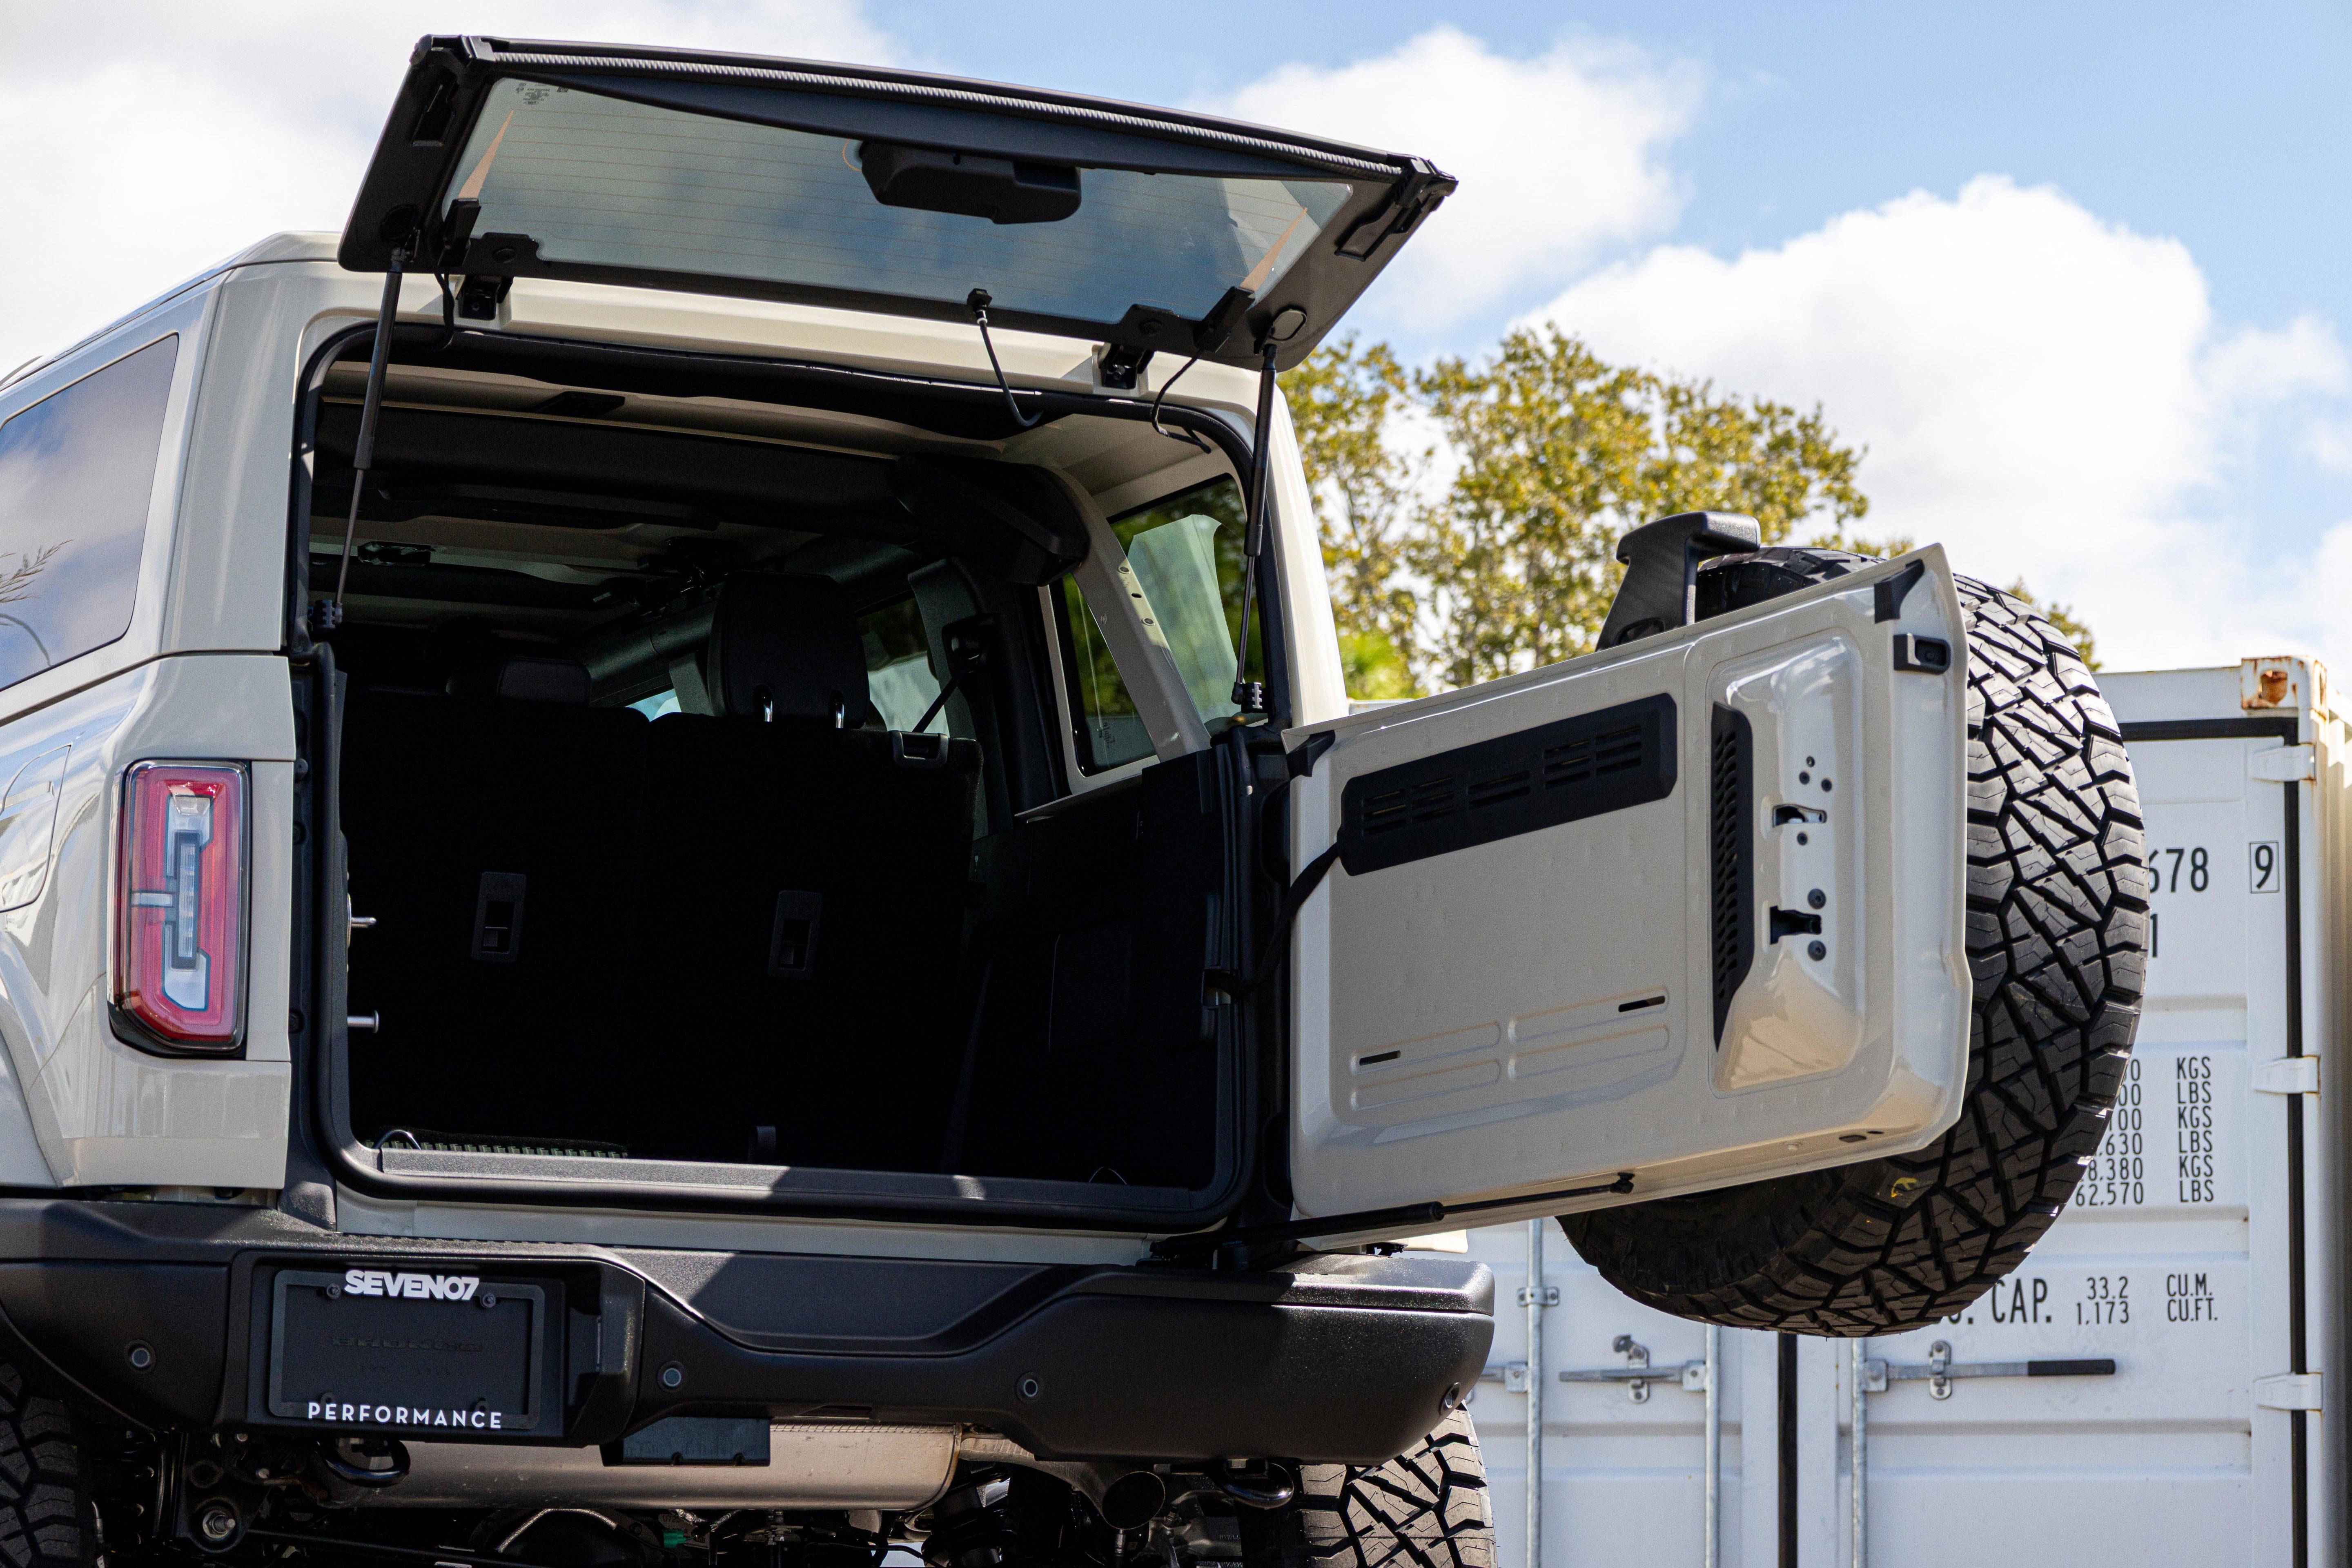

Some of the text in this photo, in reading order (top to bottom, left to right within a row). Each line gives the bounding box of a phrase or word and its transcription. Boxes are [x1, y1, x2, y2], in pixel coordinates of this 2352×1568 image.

[2256, 845, 2274, 889] 9
[2177, 1057, 2211, 1080] KGS
[2178, 1081, 2212, 1105] LBS
[2178, 1106, 2212, 1129] KGS
[2179, 1131, 2213, 1154] LBS
[2180, 1155, 2214, 1178] KGS
[2180, 1180, 2214, 1203] LBS
[1992, 1278, 2051, 1323] CAP.
[2087, 1276, 2129, 1300] 33.2
[2167, 1273, 2212, 1297] CU.M.
[2168, 1297, 2218, 1322] CU.FT.
[308, 1402, 502, 1429] PERFORMANCE
